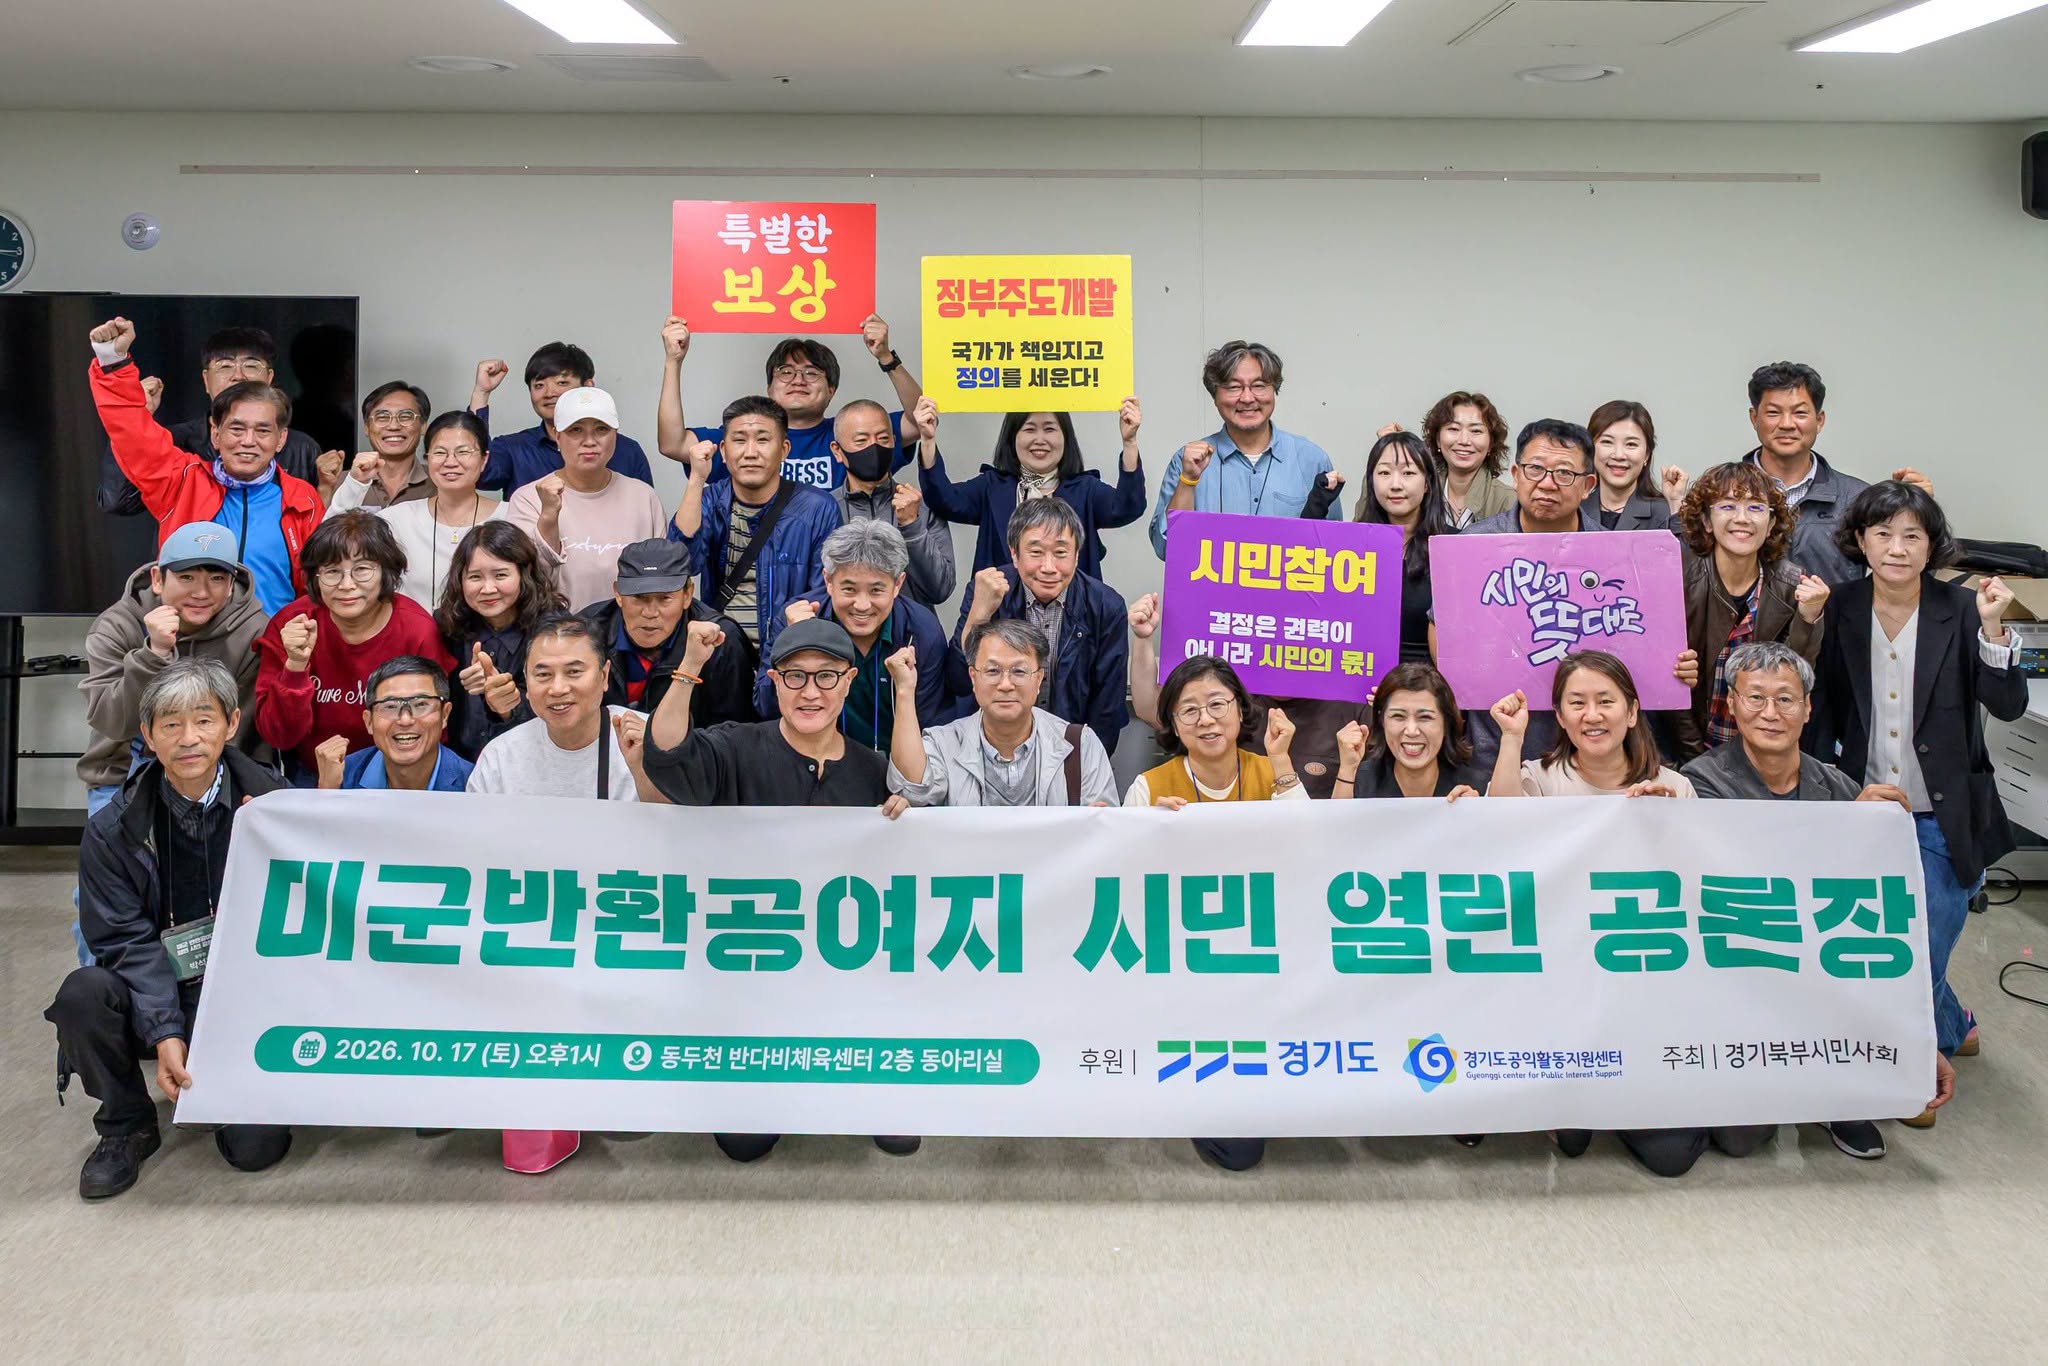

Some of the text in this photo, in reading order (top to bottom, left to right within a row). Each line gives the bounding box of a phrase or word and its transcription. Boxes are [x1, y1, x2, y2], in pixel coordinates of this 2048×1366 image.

[12, 232, 18, 241] 2
[716, 212, 833, 255] 특별한
[16, 246, 23, 256] 3
[1, 271, 7, 281] 5
[711, 258, 838, 323] 보상
[936, 278, 1118, 318] 정부주도개발
[951, 341, 1105, 362] 국가가 책임지고
[956, 367, 1099, 389] 정의를 세운다!
[779, 460, 829, 485] RESS
[1189, 538, 1378, 595] 시민참여
[1481, 558, 1569, 606] 시민의
[1208, 611, 1353, 644] 결정은 권력이
[1184, 638, 1375, 677] 아니라 시민의 몫!
[256, 858, 1917, 979] 미군반환공여지 시민 열린 공론장
[334, 1039, 403, 1061] 2026.
[411, 1041, 443, 1062] 10.
[525, 1043, 602, 1068] 오후1시
[660, 1046, 1003, 1074] 동두천 반다비체육센터 2층 동아리실
[1079, 1048, 1124, 1076] 후원
[1278, 1040, 1379, 1077] 경기도
[1463, 1050, 1623, 1070] 경기도공익활동지원센터
[1662, 1038, 1898, 1071] 주최 경기북부시민사회
[1466, 1071, 1501, 1081] Gyeonggi
[1541, 1071, 1564, 1080] Public
[1566, 1071, 1594, 1079] Interest
[1595, 1069, 1623, 1078] Support
